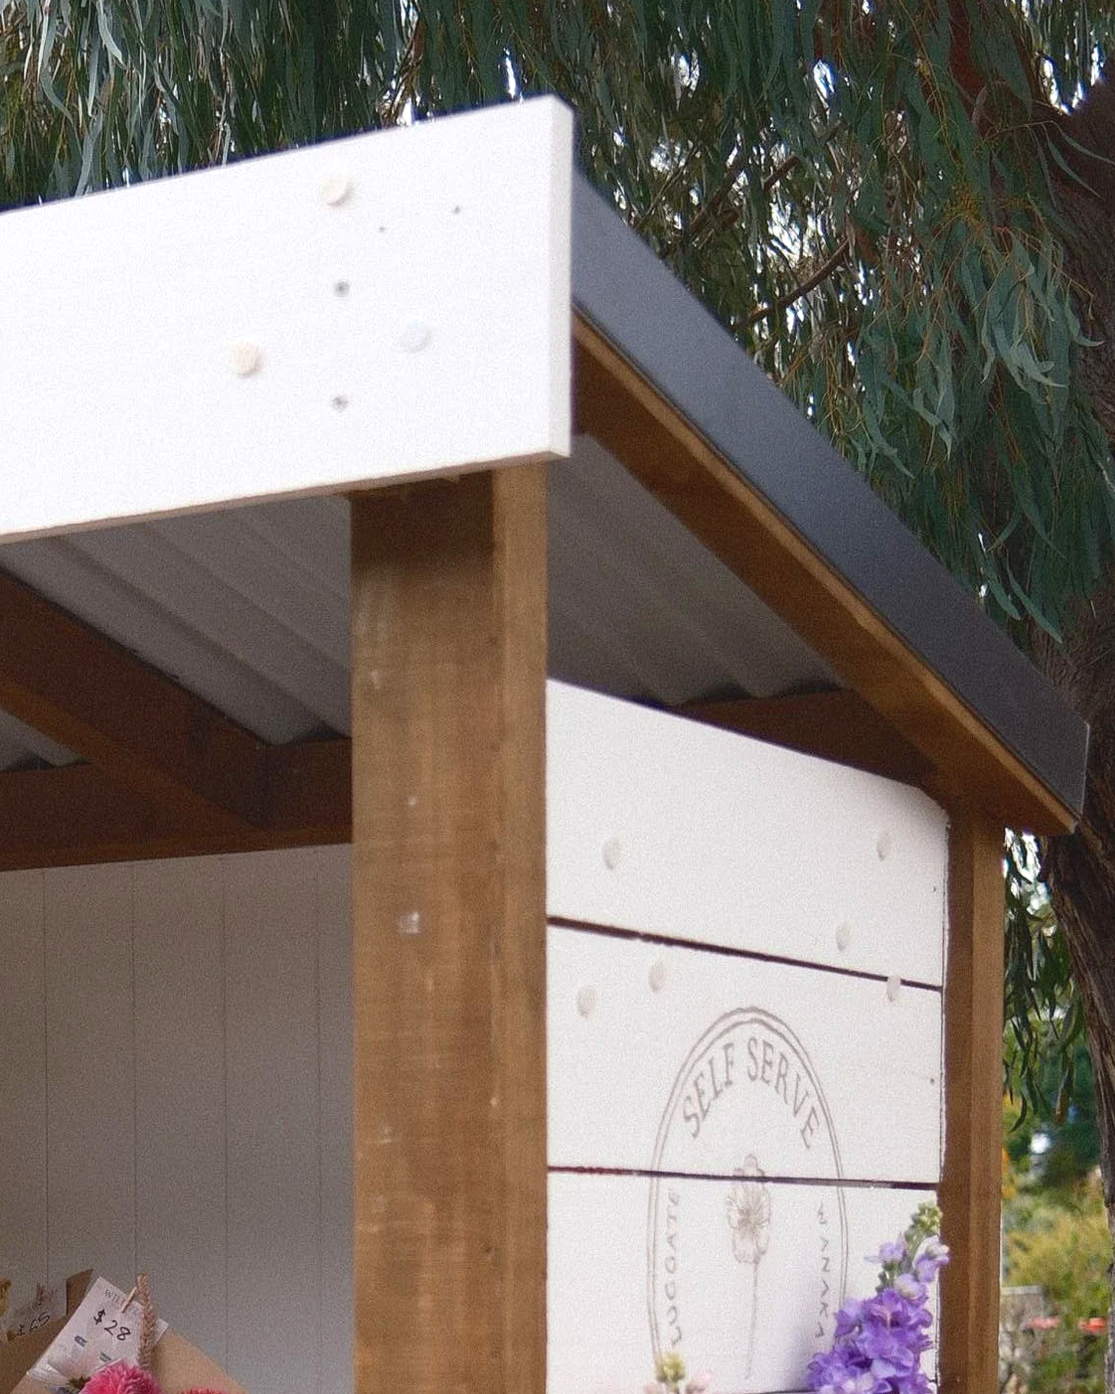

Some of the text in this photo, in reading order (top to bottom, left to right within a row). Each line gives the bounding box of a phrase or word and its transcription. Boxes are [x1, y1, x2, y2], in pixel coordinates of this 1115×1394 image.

[683, 1036, 820, 1150] SELF SERVE
[93, 1309, 131, 1341] $28
